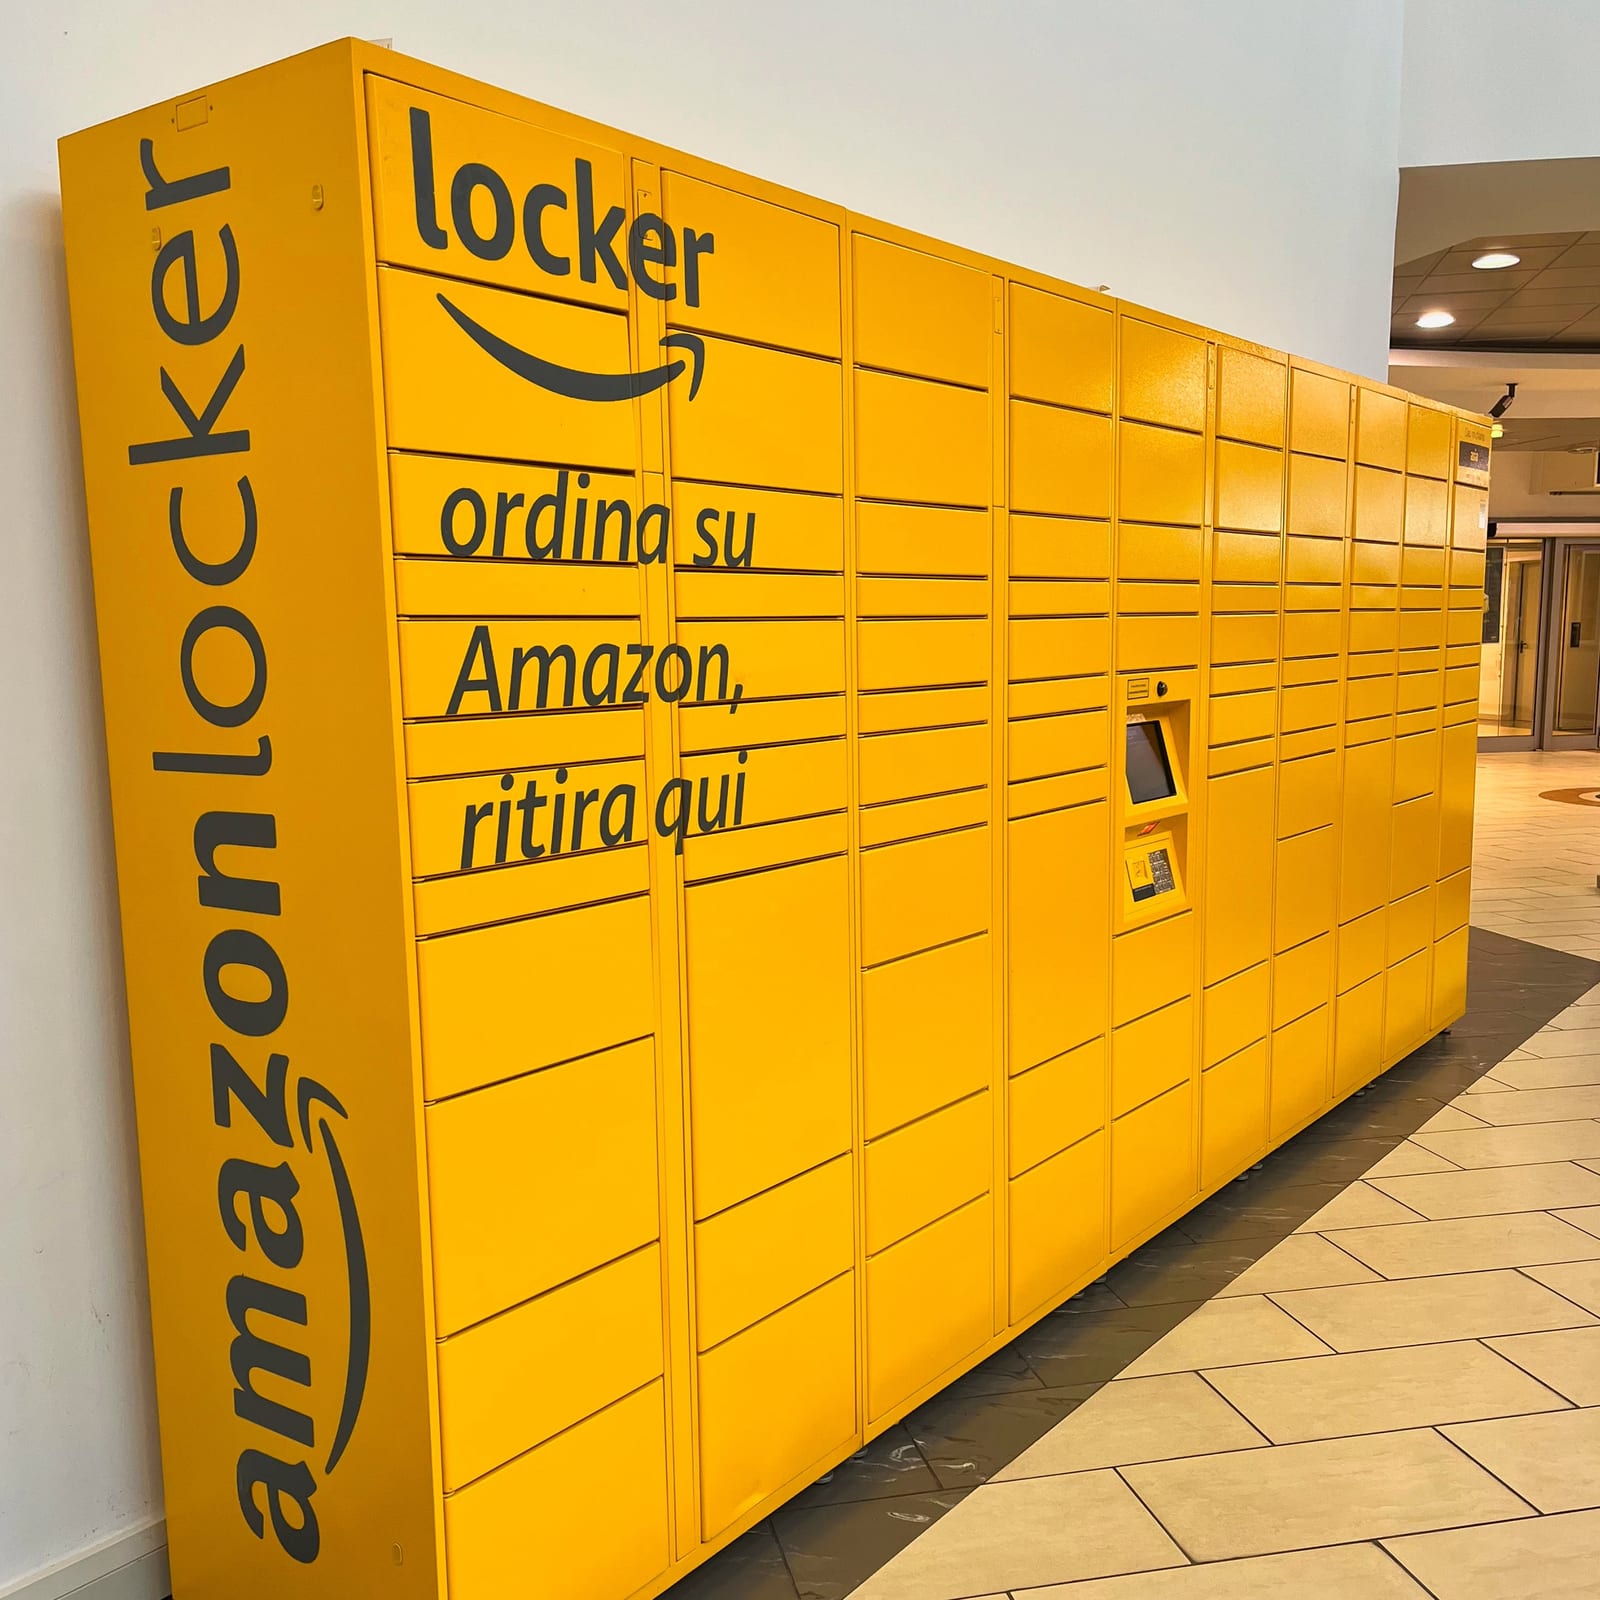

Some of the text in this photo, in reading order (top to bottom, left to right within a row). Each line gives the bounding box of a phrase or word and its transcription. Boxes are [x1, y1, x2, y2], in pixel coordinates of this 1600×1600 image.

[410, 107, 715, 308] locker
[440, 471, 757, 569] ordina su
[445, 625, 744, 715] Amazon,
[460, 750, 748, 870] ritira qui
